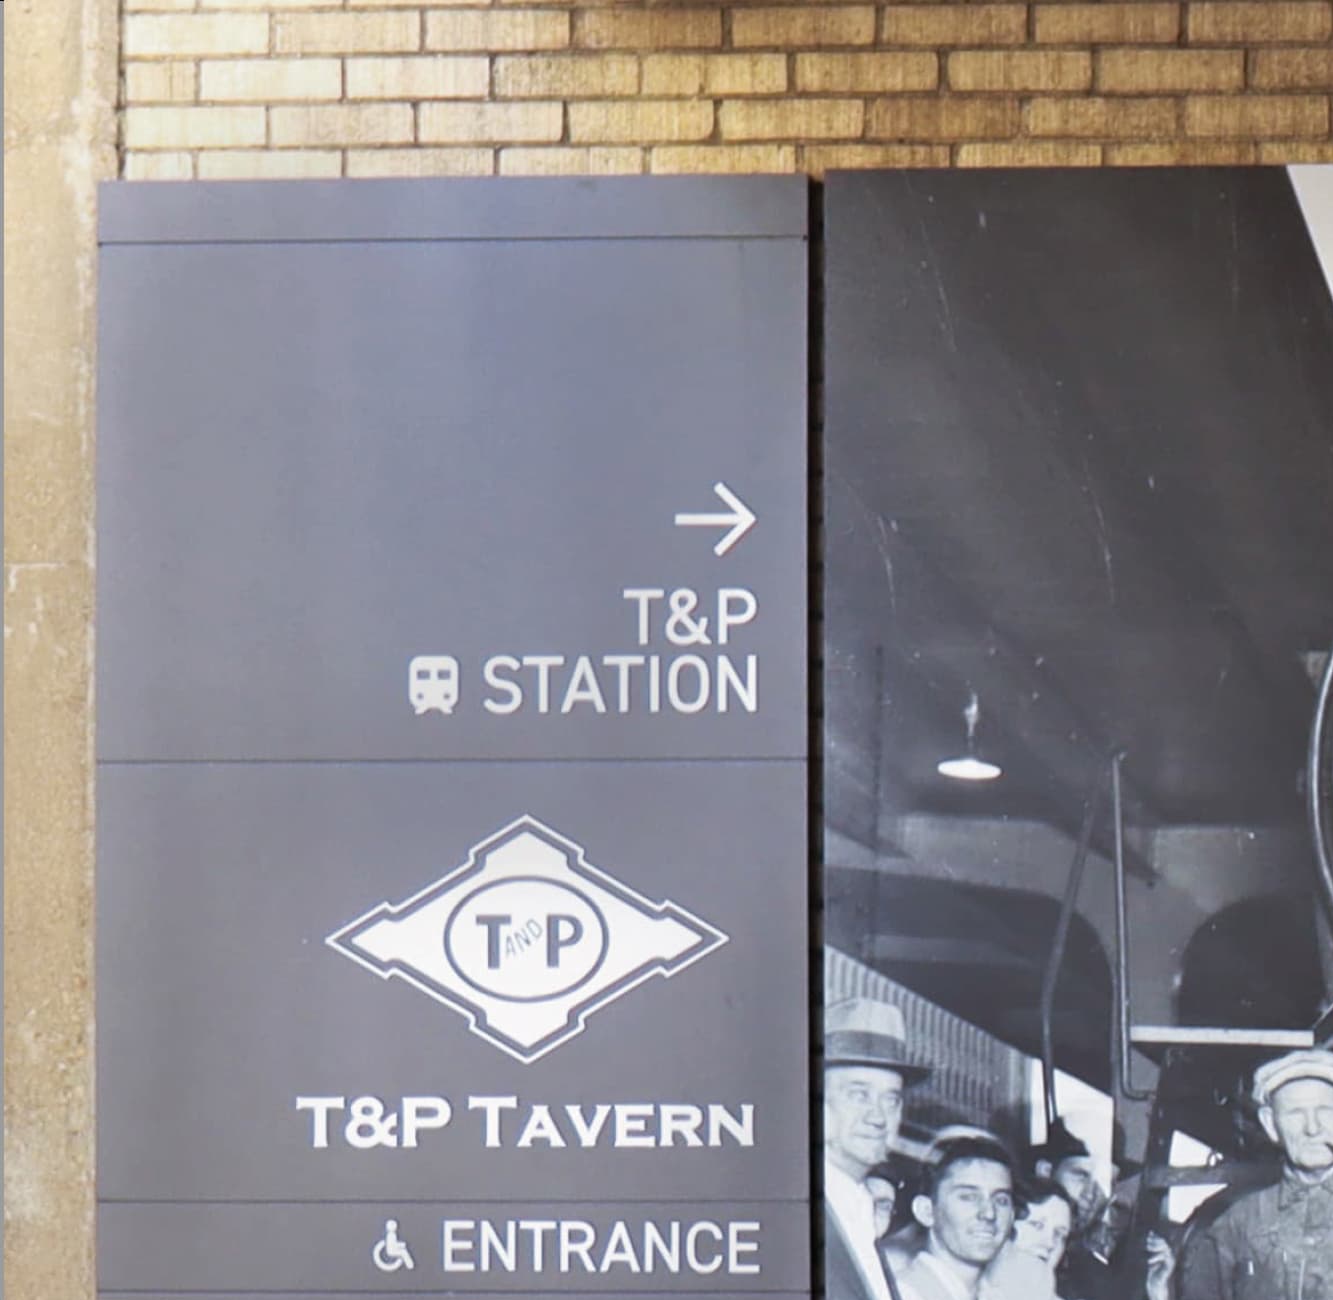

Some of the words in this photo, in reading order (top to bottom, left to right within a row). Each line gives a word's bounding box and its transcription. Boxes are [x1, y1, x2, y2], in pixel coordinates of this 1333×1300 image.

[623, 588, 757, 645] T&P
[483, 654, 758, 715] STATION
[296, 1096, 451, 1148] T&P
[468, 1096, 755, 1148] TAVERN
[443, 1220, 760, 1274] ENTRANCE
